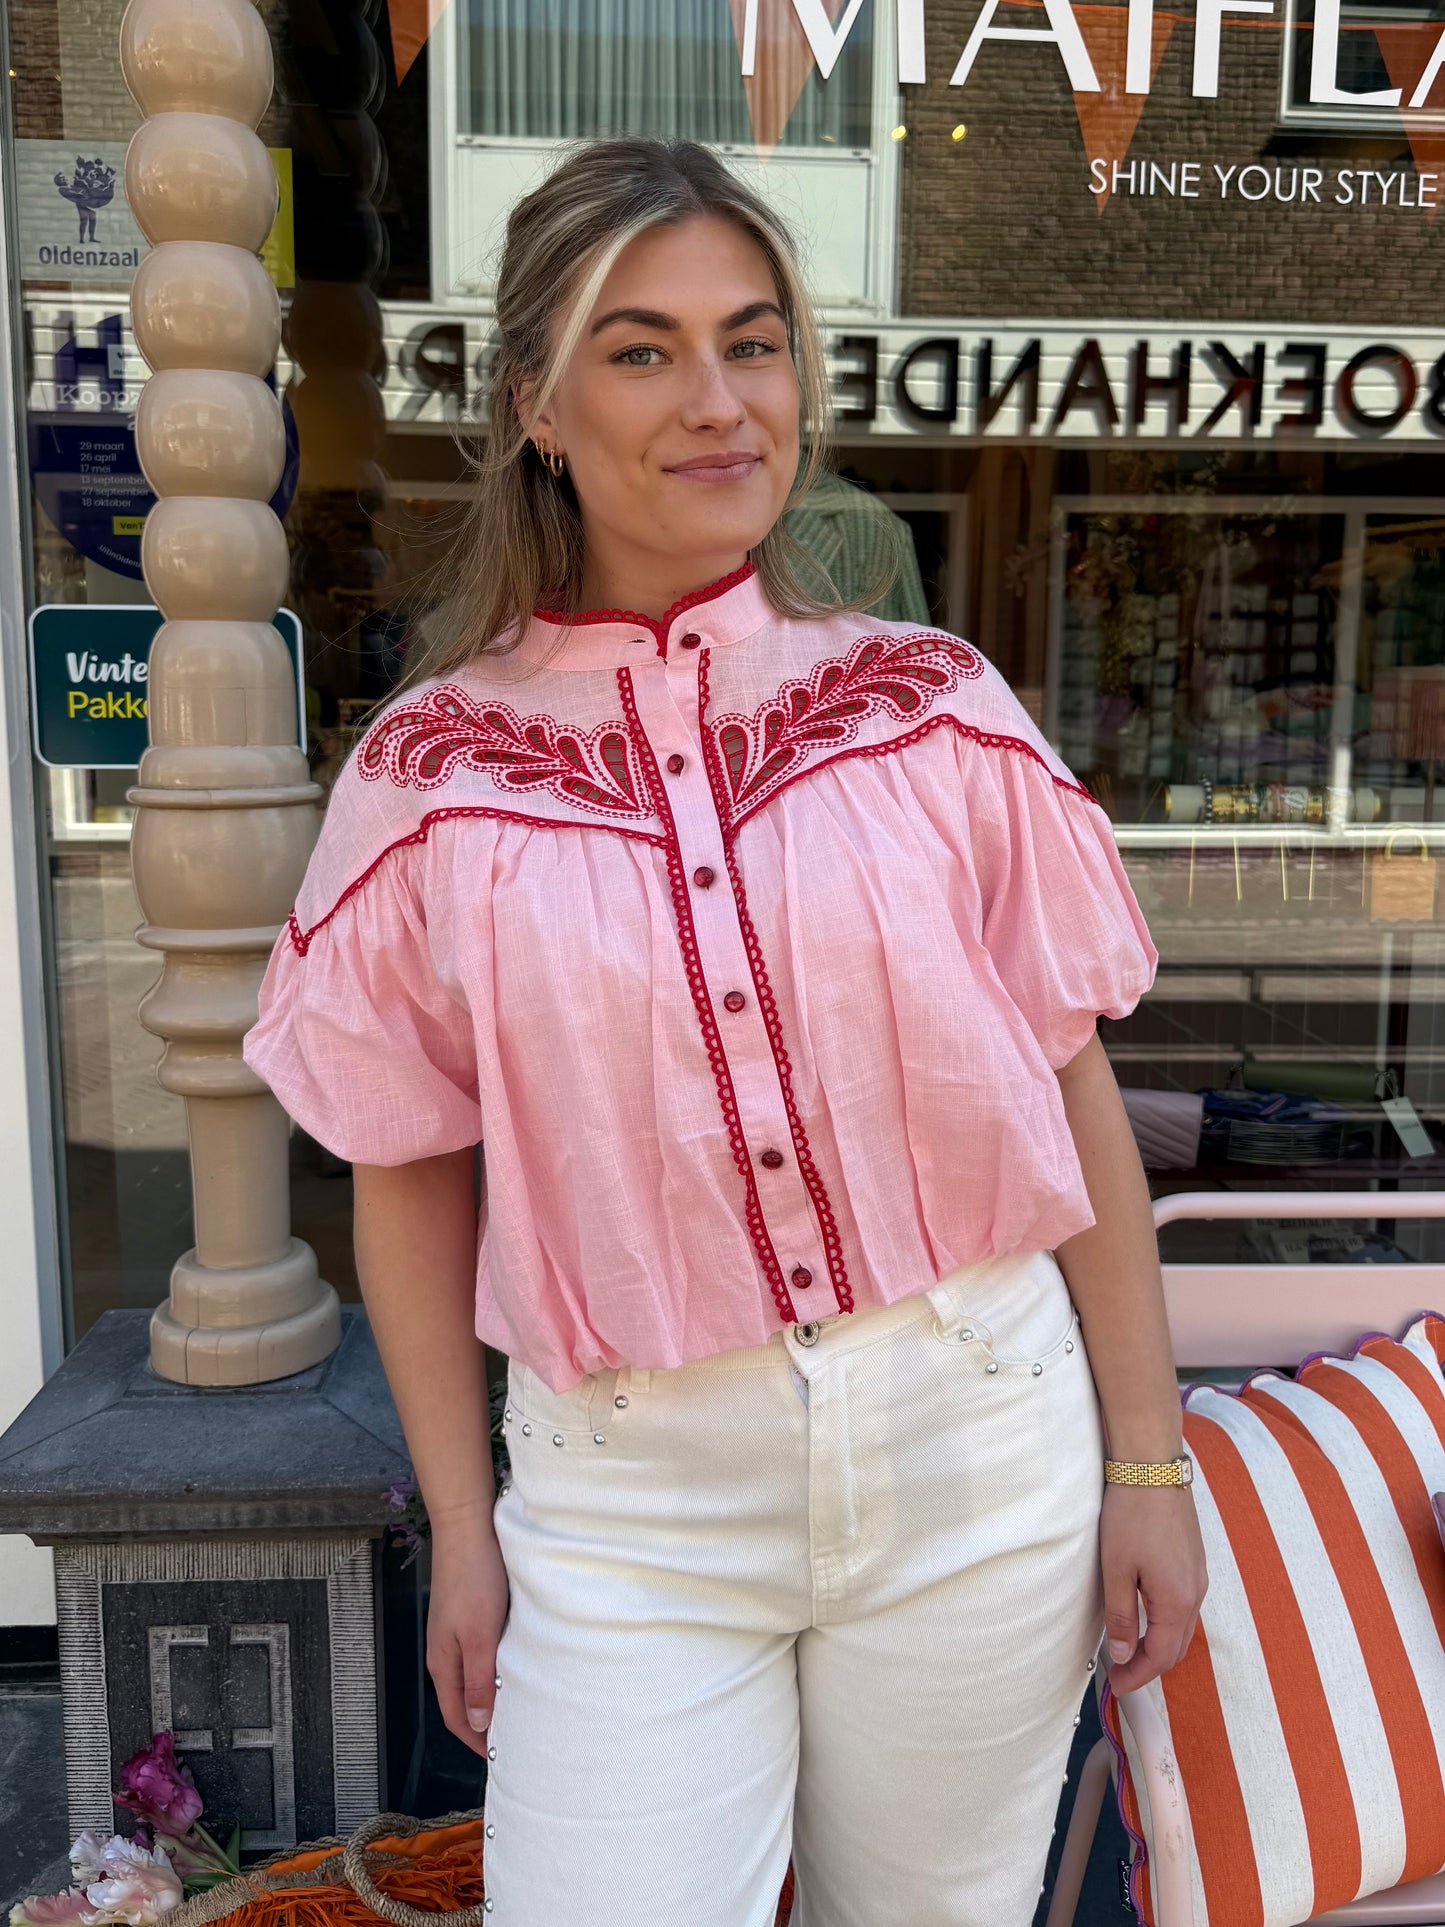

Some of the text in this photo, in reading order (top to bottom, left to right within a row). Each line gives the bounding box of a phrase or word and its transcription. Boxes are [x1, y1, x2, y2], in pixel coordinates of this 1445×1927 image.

[1088, 158, 1438, 208] SHINE YOUR STYLE
[39, 245, 139, 267] Oldenzaal
[80, 441, 125, 451] 29 maart
[80, 453, 117, 463] 26 april
[80, 464, 111, 473] 17 mei
[93, 476, 146, 486] september
[95, 487, 149, 497] september
[94, 498, 132, 507] oktober
[66, 651, 148, 684] Vinte
